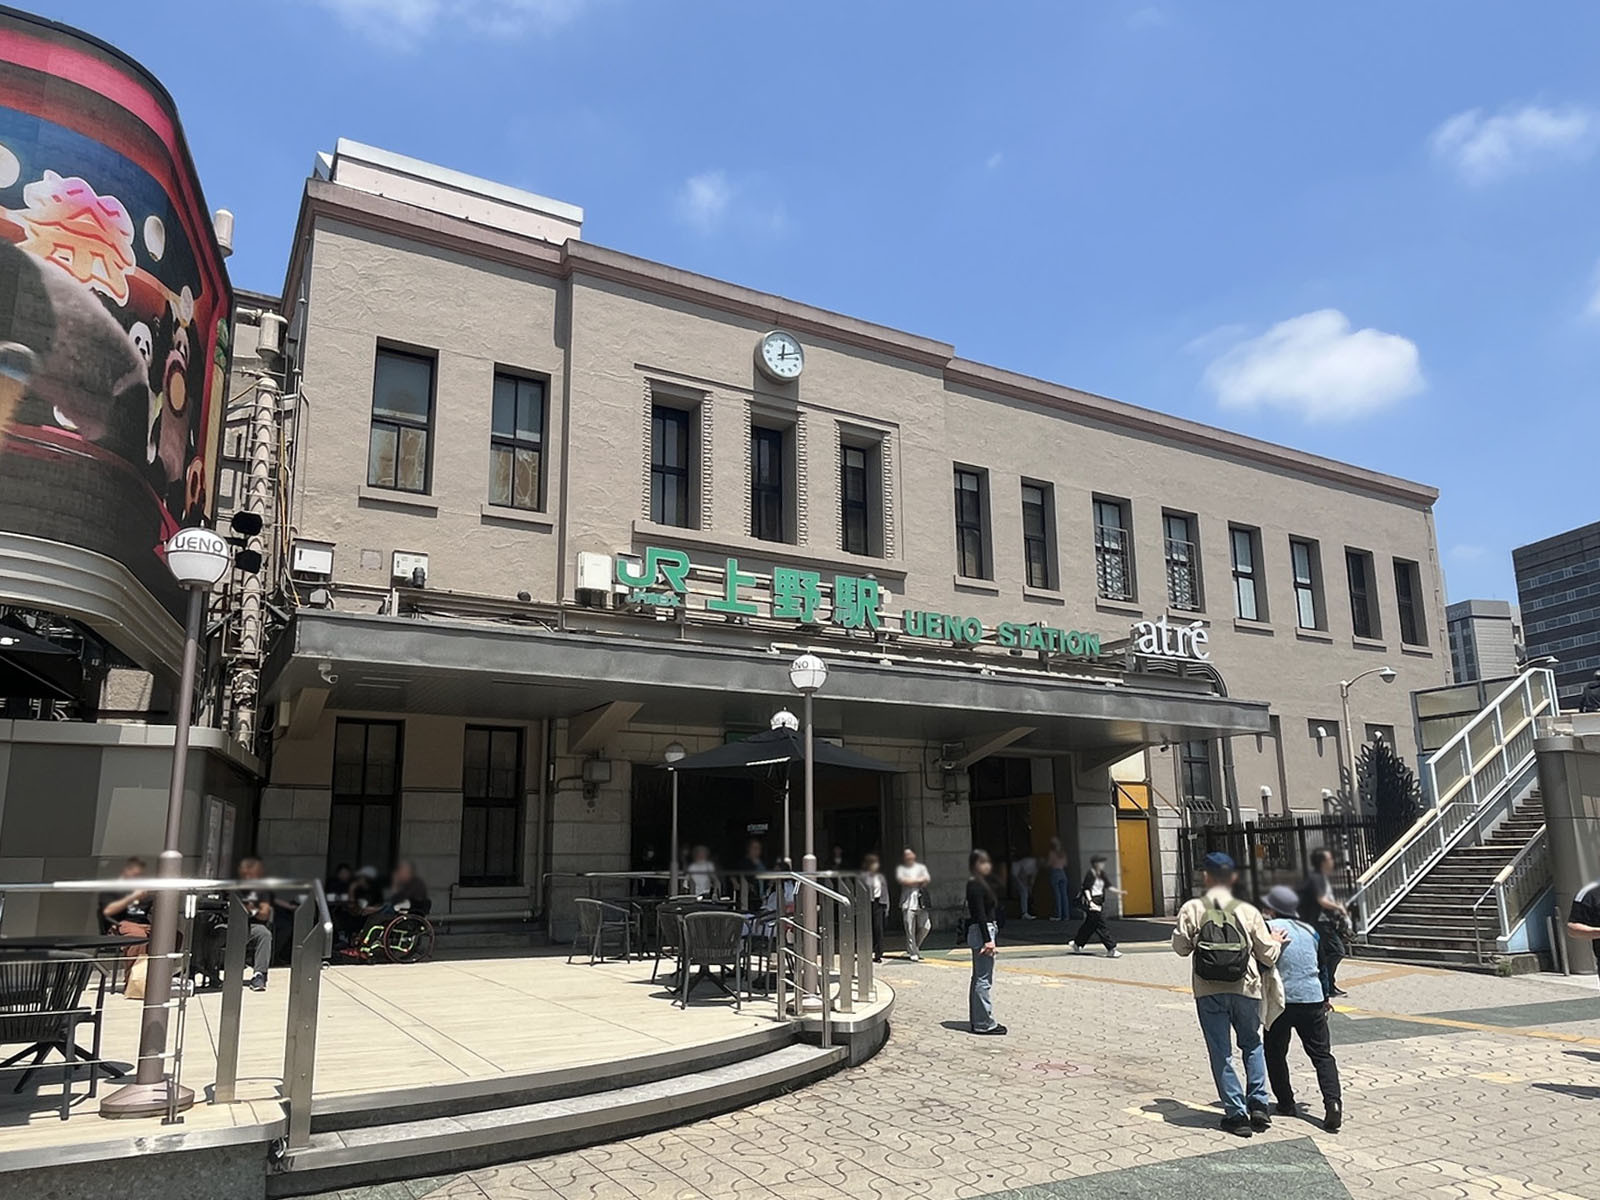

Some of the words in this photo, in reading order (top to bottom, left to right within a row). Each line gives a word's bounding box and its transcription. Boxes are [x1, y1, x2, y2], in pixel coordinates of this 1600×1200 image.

[175, 536, 224, 553] UENO
[616, 546, 690, 594] JR
[707, 557, 881, 632] 上野駅
[903, 609, 983, 643] UENO
[998, 621, 1101, 656] STATION
[1133, 614, 1210, 660] atré
